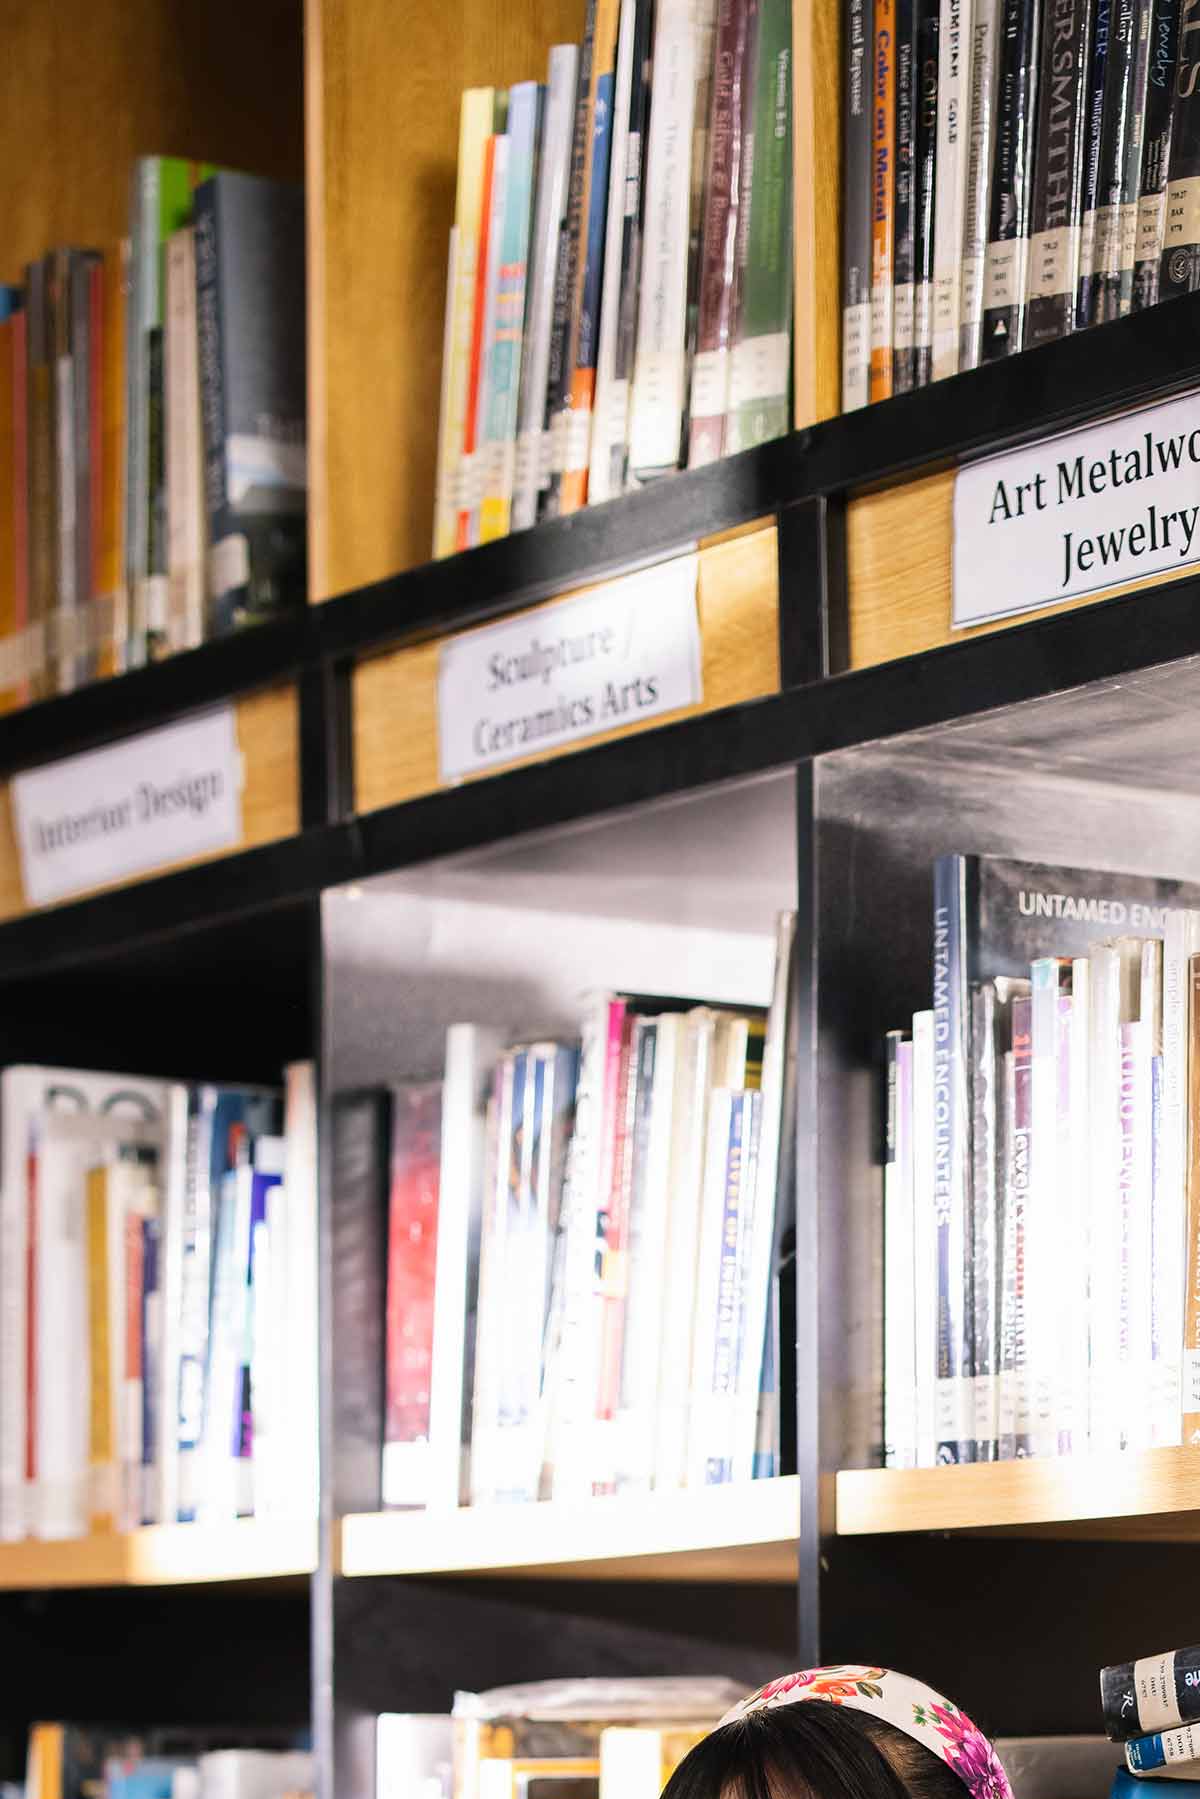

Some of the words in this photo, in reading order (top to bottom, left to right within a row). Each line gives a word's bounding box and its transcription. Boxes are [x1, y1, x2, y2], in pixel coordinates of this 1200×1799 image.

[876, 29, 890, 97] Color
[1151, 16, 1176, 87] Jewelry
[875, 108, 887, 141] on
[875, 147, 888, 222] Metal
[989, 477, 1046, 525] Art
[1062, 505, 1200, 587] Jewelry
[488, 623, 616, 693] Sculpture
[473, 692, 596, 758] Ceramics
[601, 671, 660, 728] Arts
[31, 800, 135, 858] Interior
[139, 768, 225, 828] Design
[1018, 889, 1122, 925] UNTAMED
[933, 906, 950, 1041] UNTAMED
